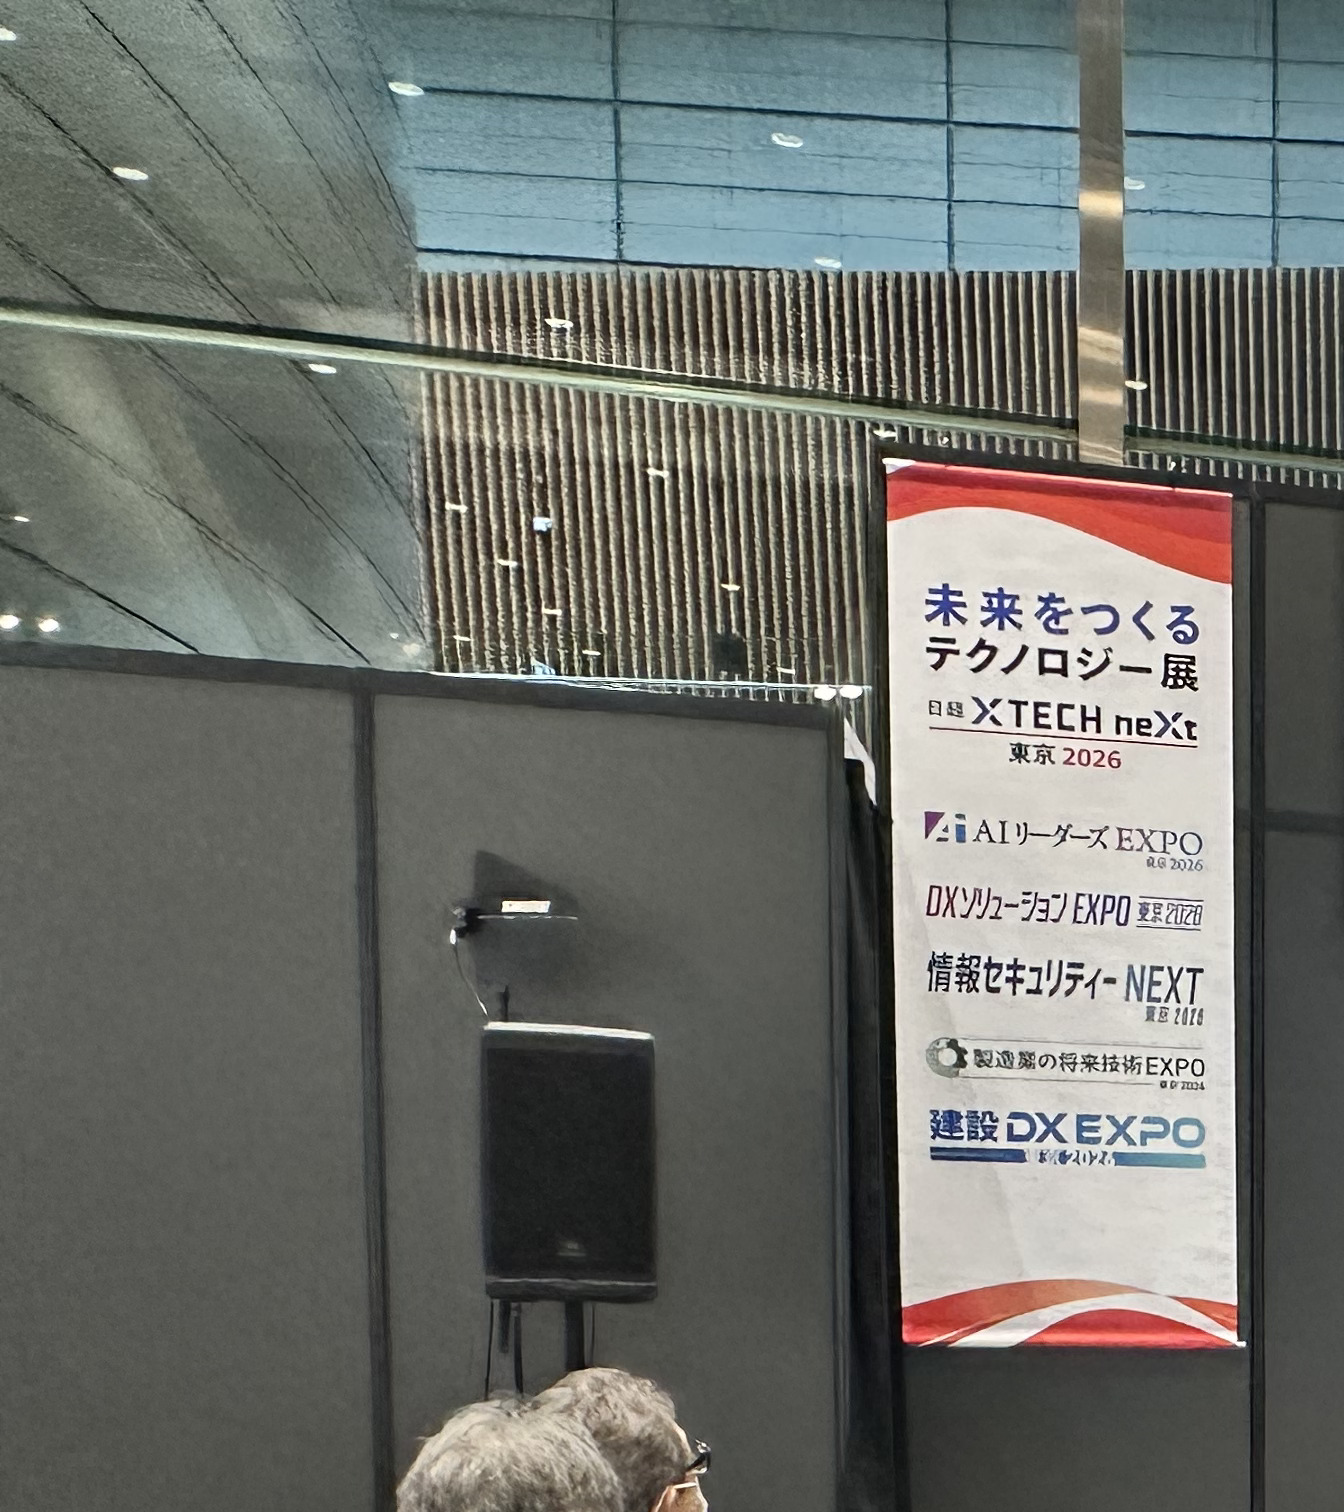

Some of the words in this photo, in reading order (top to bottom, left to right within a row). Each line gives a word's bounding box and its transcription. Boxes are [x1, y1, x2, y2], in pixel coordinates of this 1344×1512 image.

[925, 583, 1200, 645] 未来をつくる
[925, 637, 1199, 692] テクノロジー展
[1114, 710, 1198, 741] neXt
[1062, 748, 1122, 769] 2026
[1115, 826, 1204, 856] EXPO
[1072, 892, 1132, 927] EXPO
[926, 950, 1117, 1000] 情報セキュリティー
[1124, 963, 1204, 1005] NEXT
[1075, 1113, 1206, 1148] EXPO
